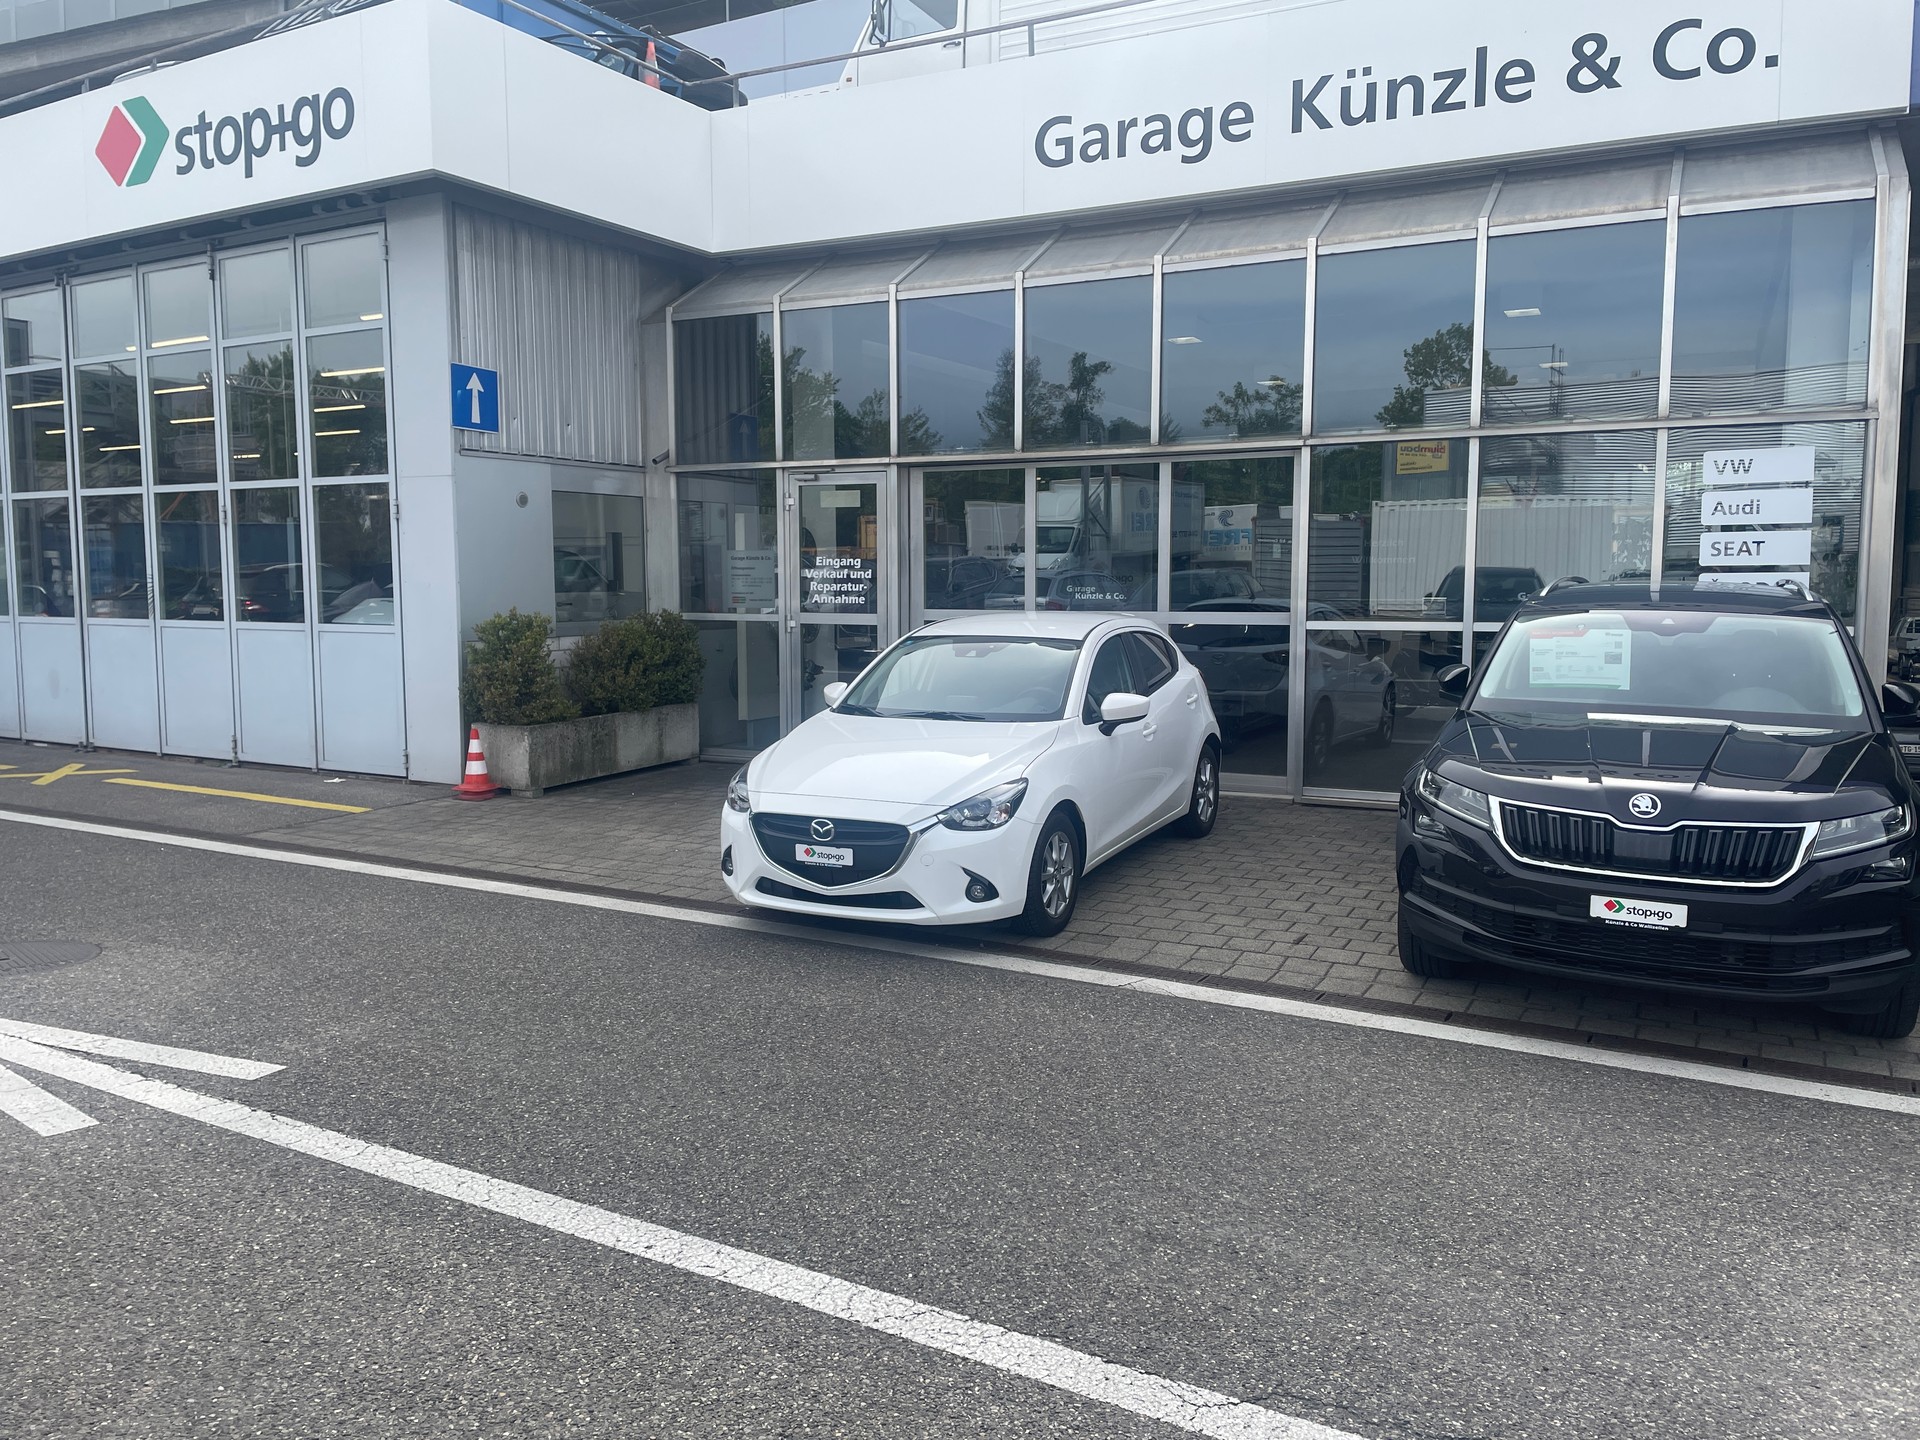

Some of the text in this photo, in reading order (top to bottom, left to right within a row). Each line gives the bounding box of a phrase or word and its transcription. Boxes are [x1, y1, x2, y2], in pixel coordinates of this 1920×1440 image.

[1035, 19, 1778, 168] Garage Künzle & Co.
[175, 87, 355, 178] stop+go
[1714, 459, 1753, 475] VW
[1711, 499, 1760, 515] Audi
[1710, 541, 1765, 557] SEAT
[816, 556, 861, 568] Eingang
[805, 569, 872, 578] Verkauf und
[810, 581, 867, 593] Reparatur-
[812, 594, 865, 604] Annahme
[817, 852, 845, 862] stop+go
[1626, 906, 1673, 920] stop+go
